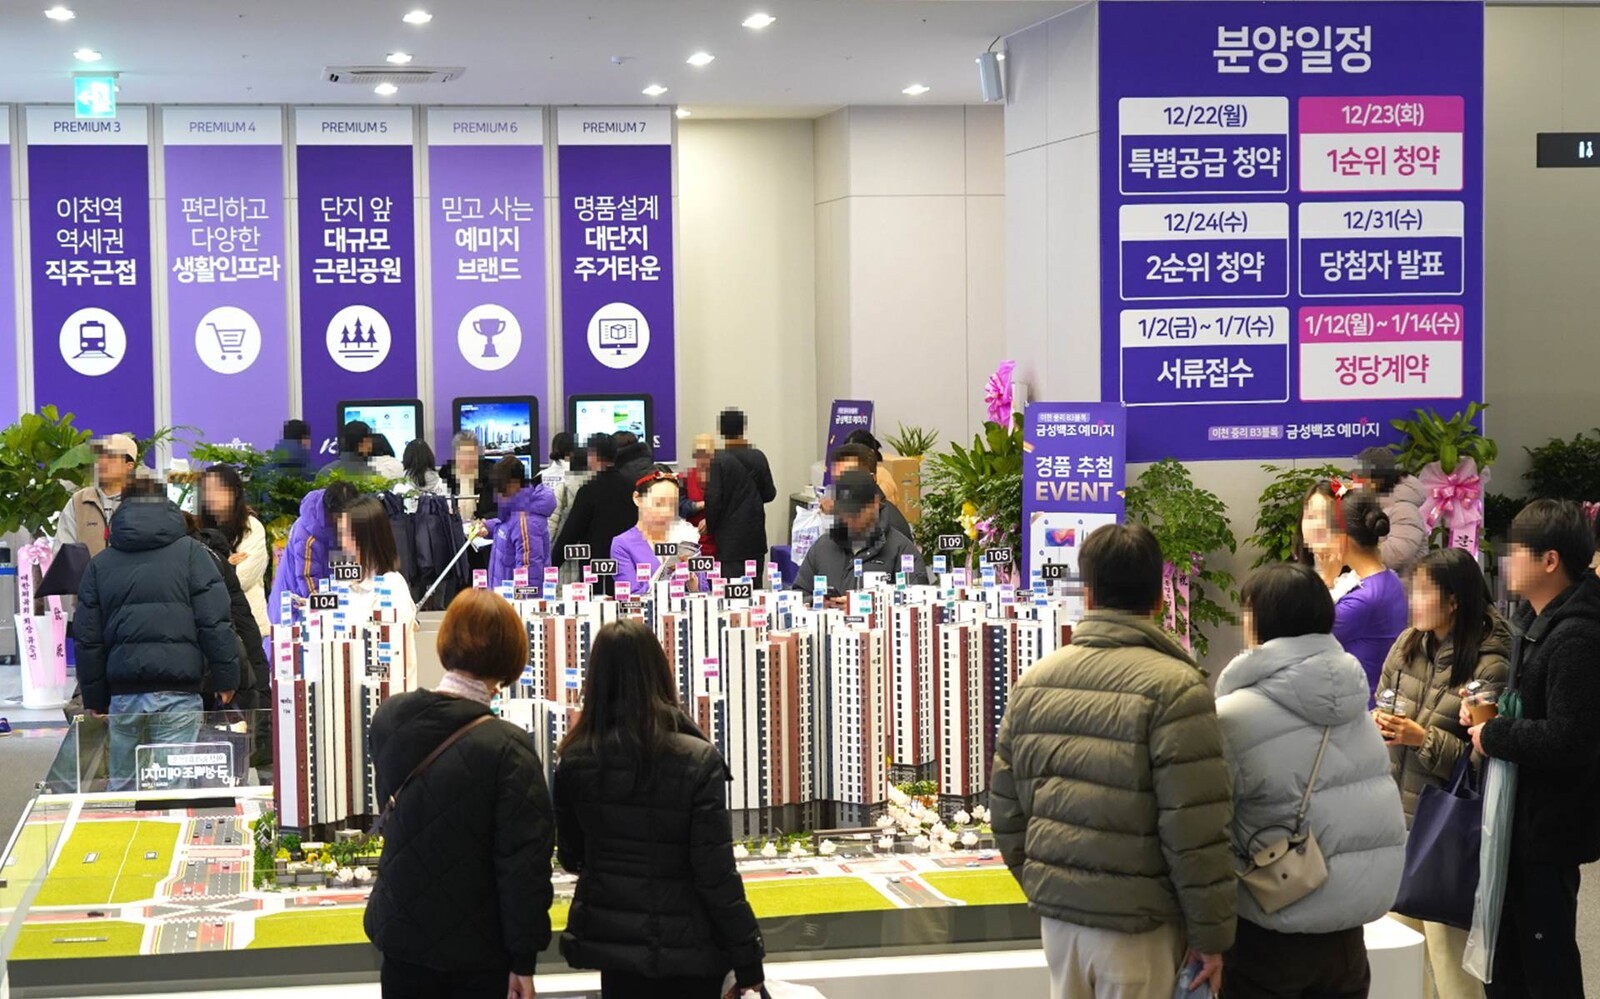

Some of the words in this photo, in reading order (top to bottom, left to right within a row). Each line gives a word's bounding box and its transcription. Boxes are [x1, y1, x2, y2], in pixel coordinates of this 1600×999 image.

[1213, 25, 1372, 74] 분양일정
[1163, 104, 1247, 127] 12/22(월)
[1341, 103, 1425, 126] 12/23(화)
[53, 122, 111, 132] PREMIUM
[114, 122, 121, 132] 3
[189, 122, 245, 132] PREMIUM
[248, 122, 256, 132] 4
[322, 122, 378, 132] PREMIUM
[380, 122, 388, 132] 5
[453, 122, 508, 132] PREMIUM
[510, 122, 518, 132] 6
[583, 122, 636, 132] PREMIUM
[638, 122, 646, 132] 7
[1128, 147, 1227, 179] 특별공급
[1232, 147, 1281, 178] 청약
[1326, 146, 1386, 176] 1순위
[1393, 145, 1440, 176] 청약
[57, 197, 122, 223] 이천역
[181, 197, 269, 222] 편리하고
[322, 197, 363, 222] 단지
[370, 196, 392, 222] 앞
[442, 197, 484, 222] 믿고
[489, 197, 534, 222] 사는
[574, 196, 659, 221] 명품설계
[1342, 208, 1422, 230] 12/31(수)
[1164, 211, 1248, 233] 12/24(수)
[56, 228, 124, 254] 역세권
[191, 226, 260, 252] 다양한
[324, 228, 390, 253] 대규모
[455, 226, 520, 252] 예미지
[585, 225, 648, 251] 대단지
[45, 259, 136, 286] 직주근접
[172, 256, 280, 283] 생활인프라
[312, 257, 401, 284] 근린공원
[456, 257, 522, 282] 브랜드
[574, 256, 661, 282] 주거타운
[1146, 252, 1210, 282] 2순위
[1216, 252, 1264, 282] 청약
[1320, 250, 1392, 281] 당첨자
[1398, 250, 1445, 279] 발표
[1138, 317, 1197, 340] 1/2(금)
[1215, 315, 1274, 338] 1/7(수)
[1305, 312, 1374, 336] 1/12(월)
[1392, 312, 1460, 335] 1/14(수)
[1157, 358, 1254, 389] 서류접수
[1335, 354, 1429, 386] 정당계약
[1036, 424, 1077, 437] 금성백조
[1078, 424, 1114, 437] 예미지
[1212, 427, 1228, 439] 이천
[1286, 424, 1336, 439] 금성백조
[1337, 422, 1380, 438] 예미지
[1036, 456, 1072, 478] 경품
[1076, 456, 1114, 478] 추첨
[1036, 482, 1114, 502] EVENT
[568, 548, 586, 558] 111
[656, 544, 676, 555] 110
[943, 538, 960, 548] 109
[594, 562, 614, 574] 107
[692, 560, 712, 570] 106
[989, 551, 1008, 562] 105
[338, 568, 358, 579] 108
[1045, 566, 1064, 577] 10
[314, 596, 336, 608] 104
[728, 586, 749, 598] 102
